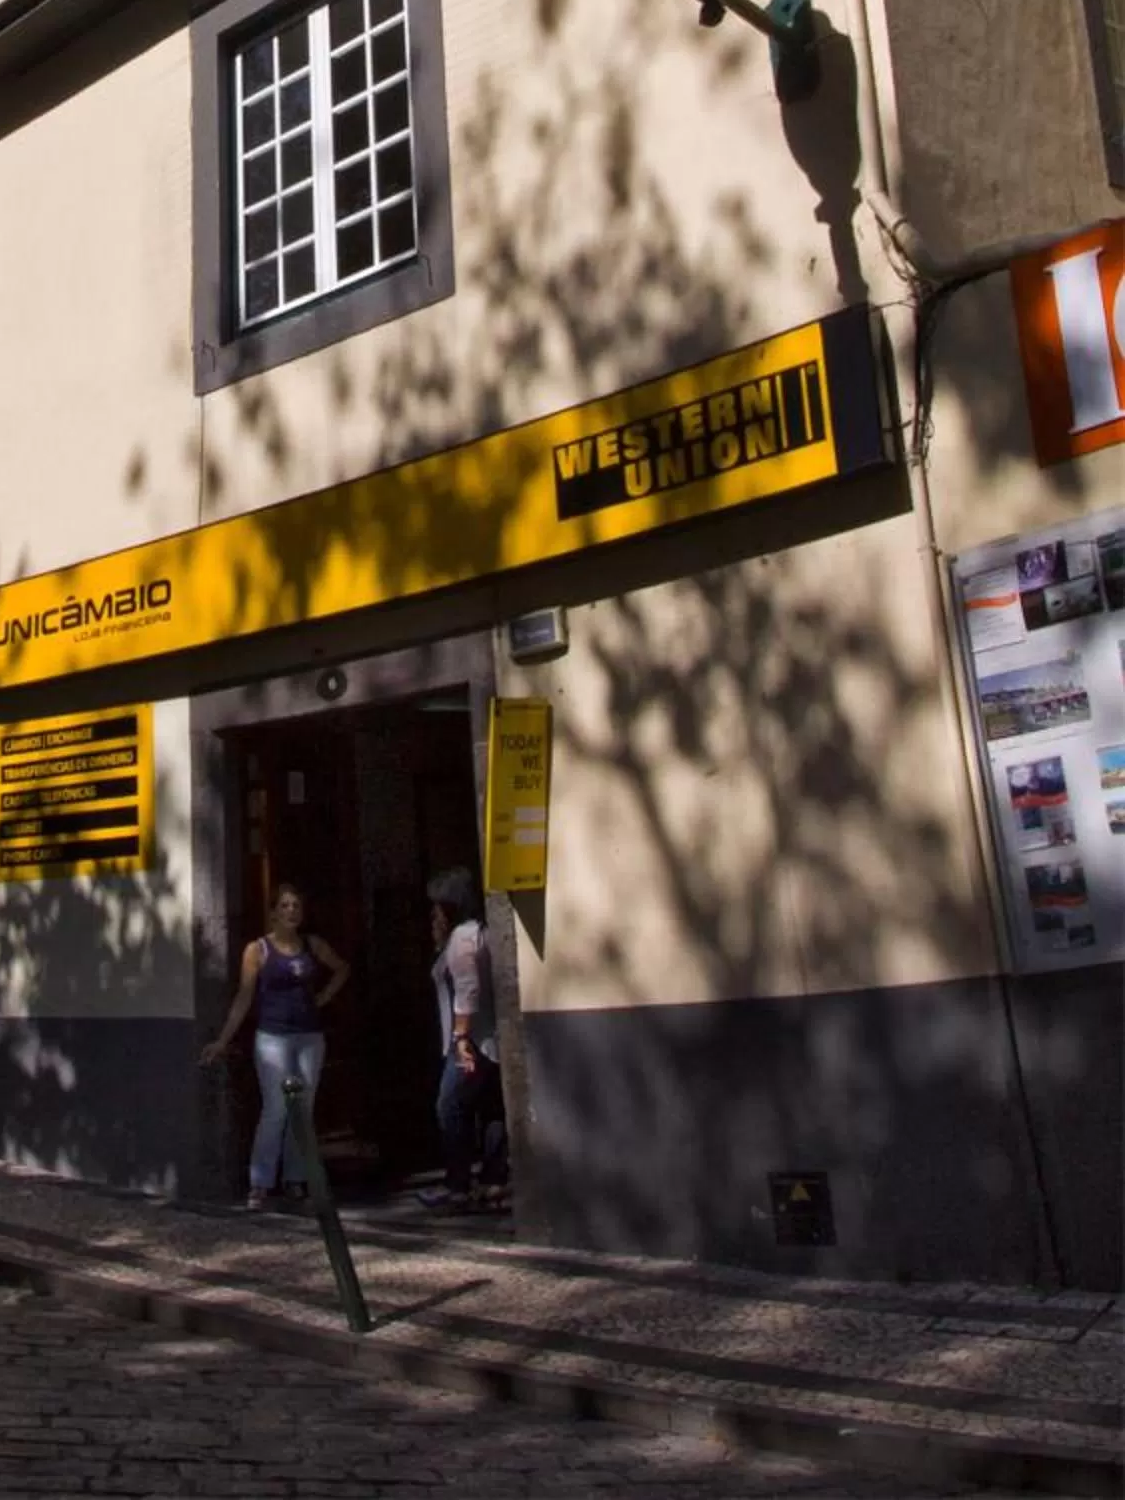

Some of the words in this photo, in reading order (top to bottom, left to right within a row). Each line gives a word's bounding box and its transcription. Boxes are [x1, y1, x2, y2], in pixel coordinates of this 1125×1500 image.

[556, 378, 772, 481] WESTERN
[624, 417, 777, 497] UNION
[499, 734, 542, 751] TODAY
[512, 774, 542, 790] BUY
